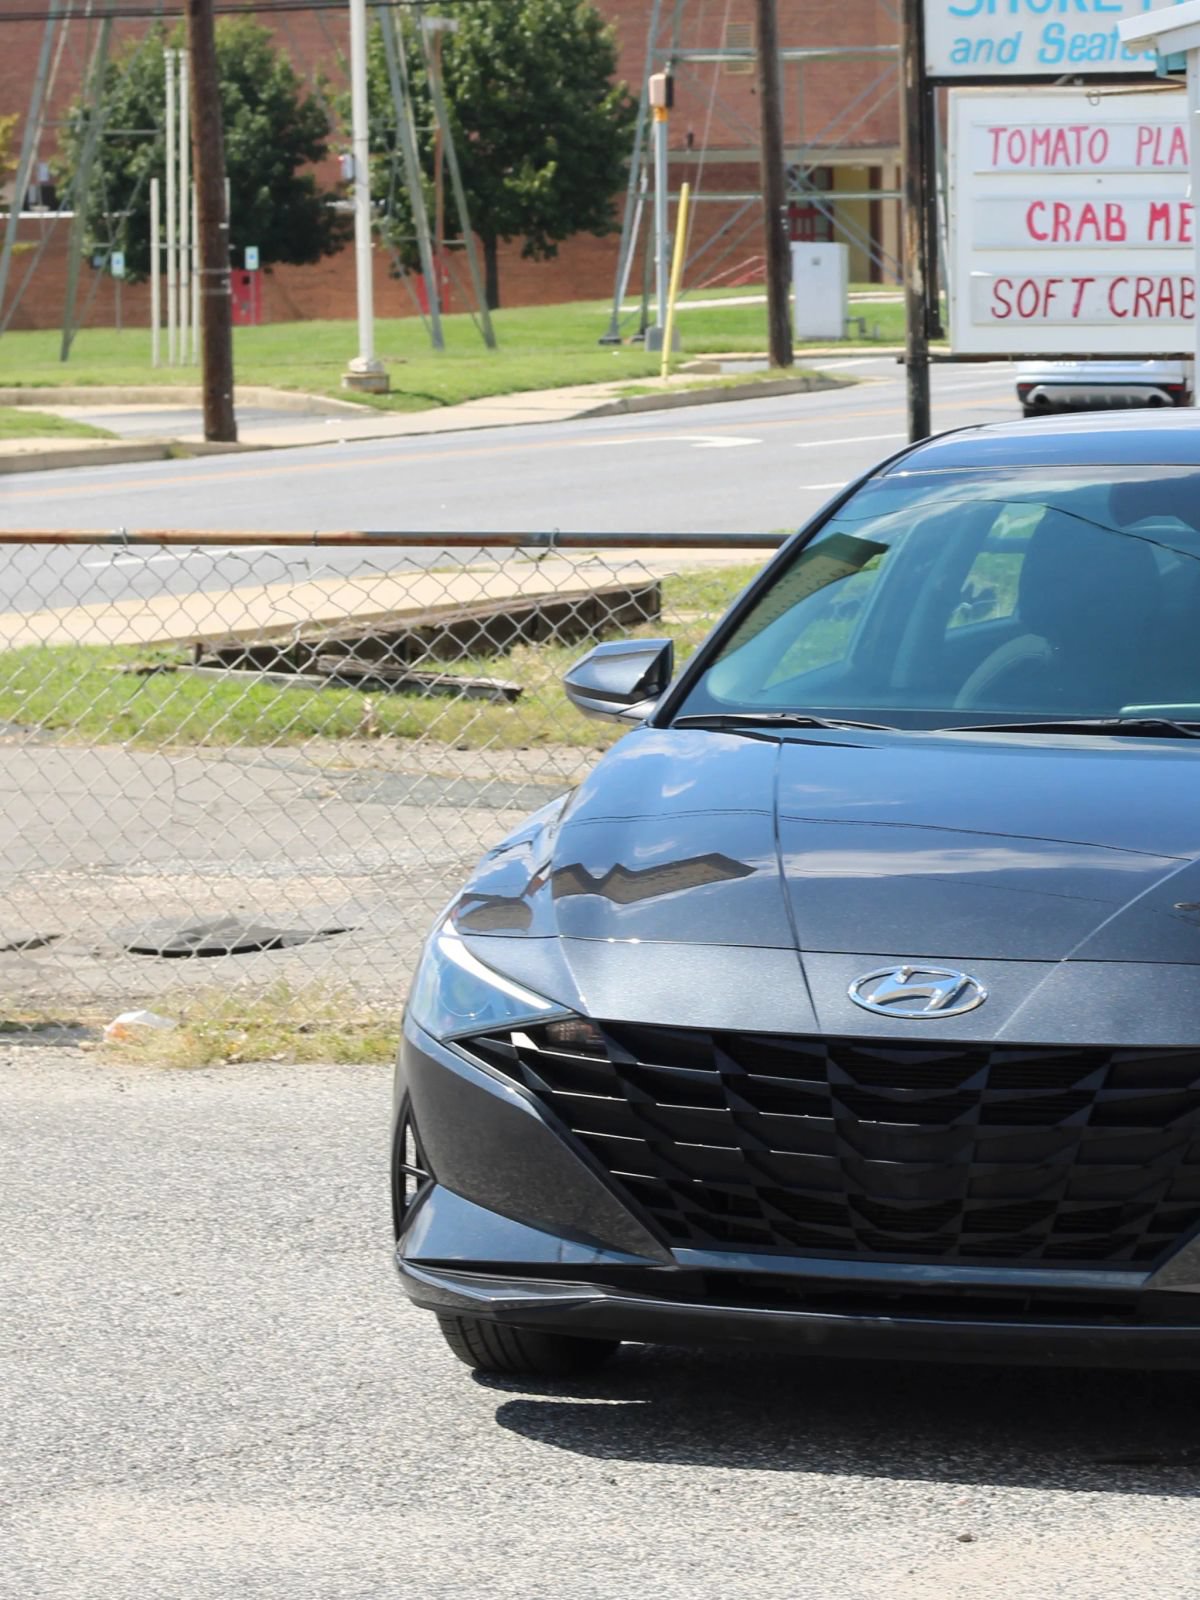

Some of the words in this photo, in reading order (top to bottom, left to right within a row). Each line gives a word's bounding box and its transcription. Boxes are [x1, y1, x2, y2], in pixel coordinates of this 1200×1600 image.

[951, 31, 1023, 64] and
[987, 126, 1109, 166] TOMATO
[1136, 126, 1189, 166] PLA
[1026, 200, 1127, 242] CRAB
[1147, 202, 1195, 242] ME
[991, 277, 1096, 319] SOFT
[1108, 276, 1195, 319] CRAB
